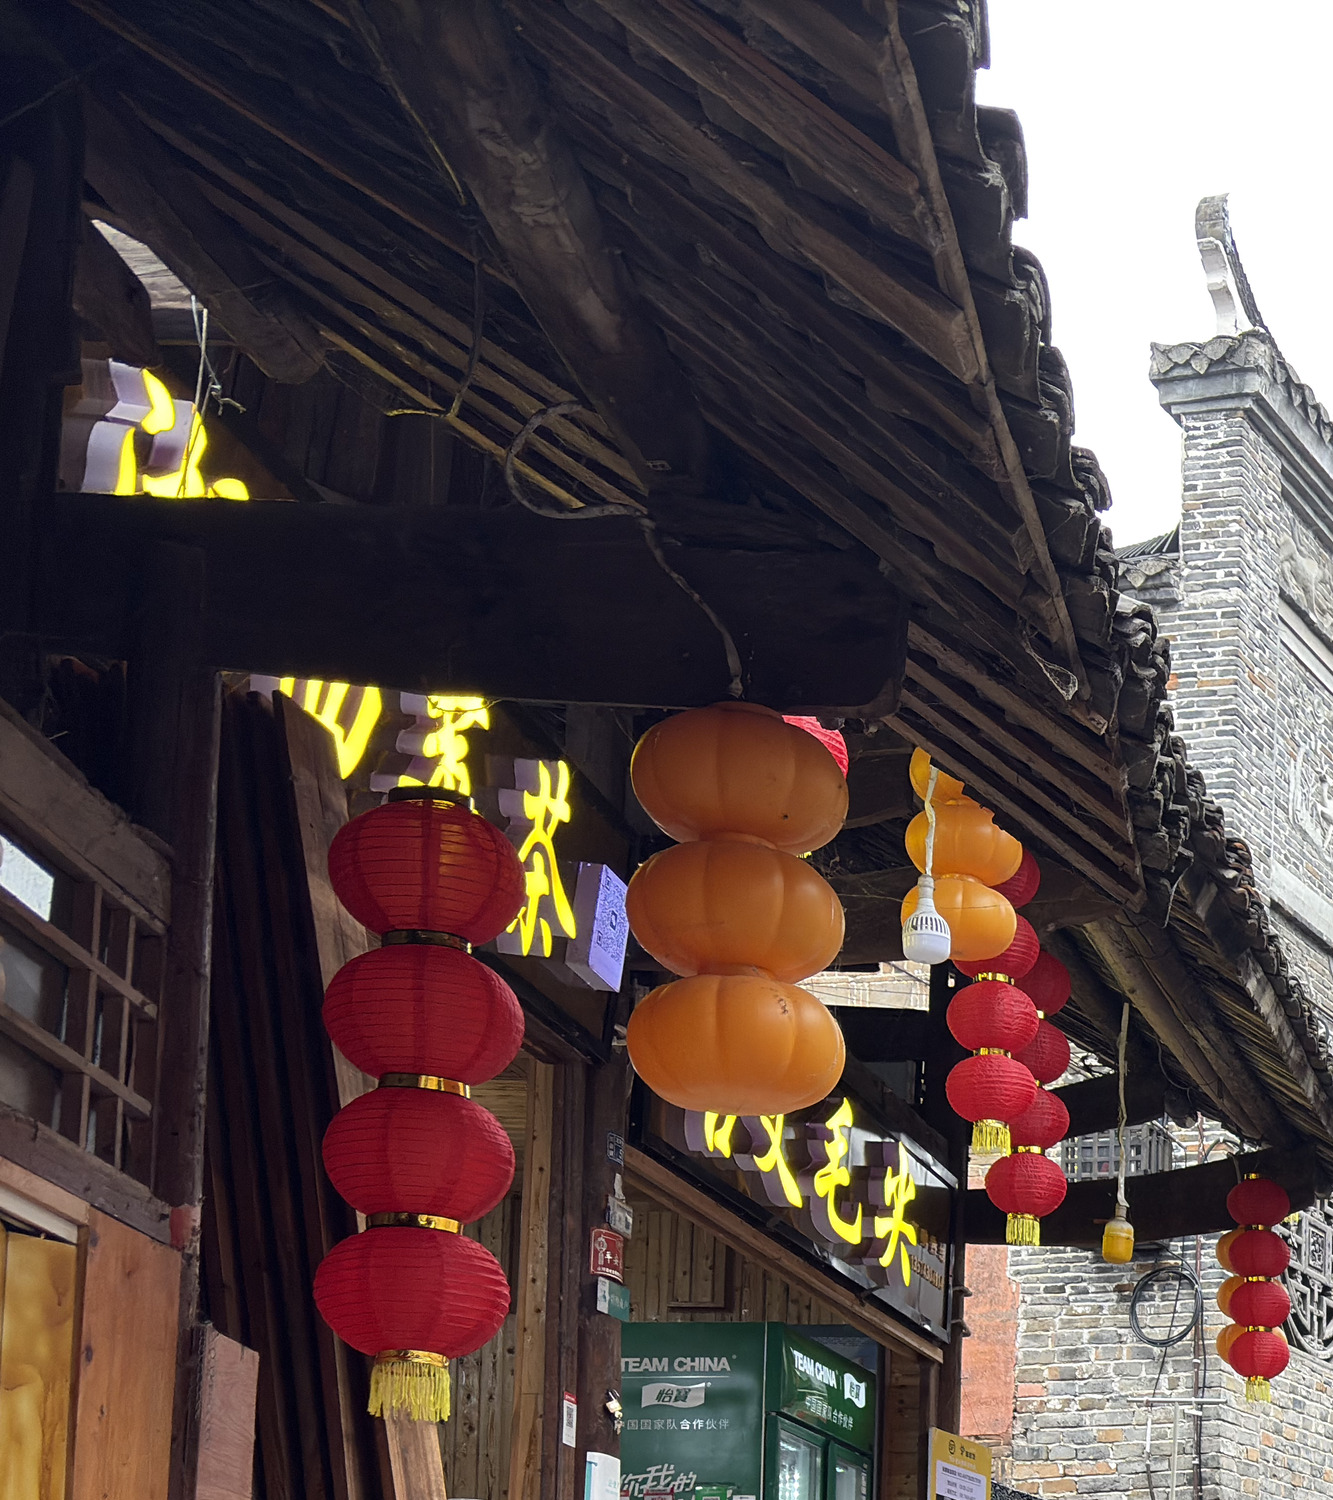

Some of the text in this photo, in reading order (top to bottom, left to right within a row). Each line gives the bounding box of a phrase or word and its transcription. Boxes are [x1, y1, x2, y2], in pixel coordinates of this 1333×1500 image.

[621, 1356, 731, 1372] TEAM CHINA
[793, 1349, 837, 1389] TEAM CHINA
[623, 1419, 730, 1430] 国国家队合作伙伴
